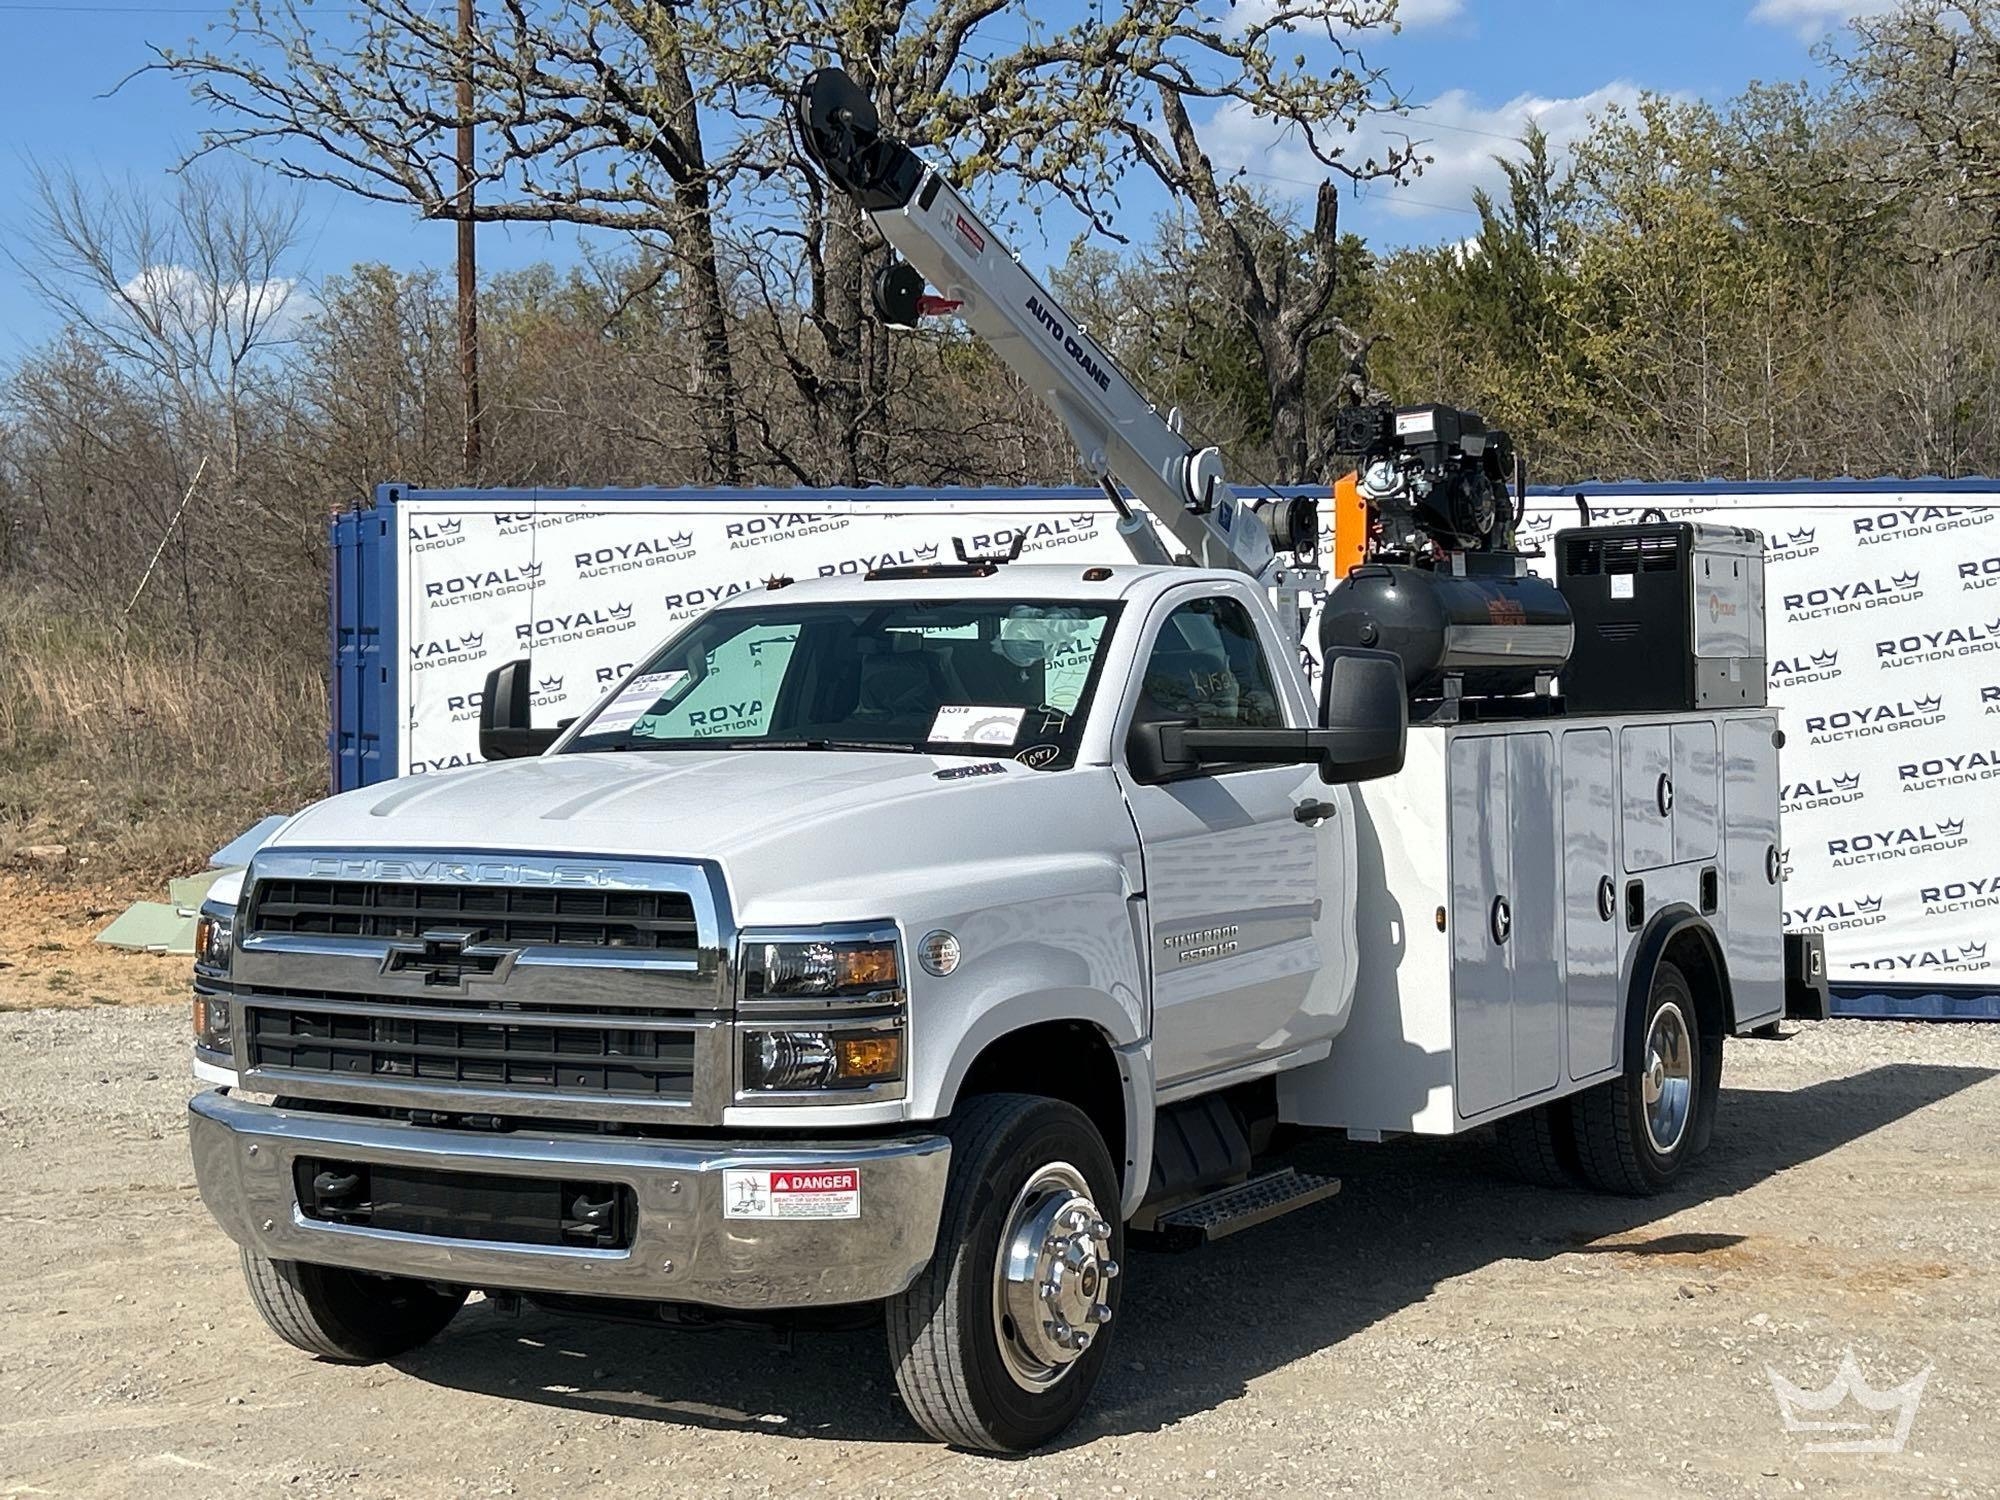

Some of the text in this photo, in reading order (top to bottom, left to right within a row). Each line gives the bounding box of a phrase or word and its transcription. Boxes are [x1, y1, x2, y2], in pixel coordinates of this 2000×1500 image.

[1025, 296, 1111, 392] AUTO CRANE
[730, 520, 850, 550] AUCTION GROUP
[972, 520, 1070, 550] ROYAL
[1853, 507, 1962, 534] ROYAL
[1858, 514, 1994, 546] AUCTION GROUP
[415, 536, 466, 552] GROUP
[575, 539, 670, 568] ROYAL
[1046, 531, 1099, 548] GROUP
[579, 549, 697, 580] AUCTION GROUP
[818, 551, 914, 578] ROYAL
[426, 568, 519, 598] ROYAL
[430, 579, 546, 609] AUCTION GROUP
[1783, 579, 1892, 611] ROYAL
[1788, 591, 1924, 622] AUCTION GROUP
[515, 610, 609, 639] ROYAL
[520, 621, 637, 650] AUCTION GROUP
[1876, 626, 1986, 657] ROYAL
[437, 650, 487, 667] GROUP
[1880, 649, 1955, 670] AUCTION
[1784, 669, 1842, 687] GROUP
[689, 700, 763, 726] ROYA
[1806, 703, 1914, 733] ROYAL
[694, 719, 758, 737] AUCTION
[1810, 715, 1946, 745] AUCTION GROUP
[1903, 773, 1977, 793] AUCTION
[1806, 792, 1864, 809] GROUP
[1828, 826, 1936, 856] ROYAL
[1832, 838, 1968, 868] AUCTION GROUP
[308, 857, 624, 887] CHEVROLET
[1925, 896, 1999, 916] AUCTION
[1163, 924, 1238, 950] SILVERADO
[1828, 915, 1886, 931] GROUP
[792, 1175, 852, 1190] DANGER
